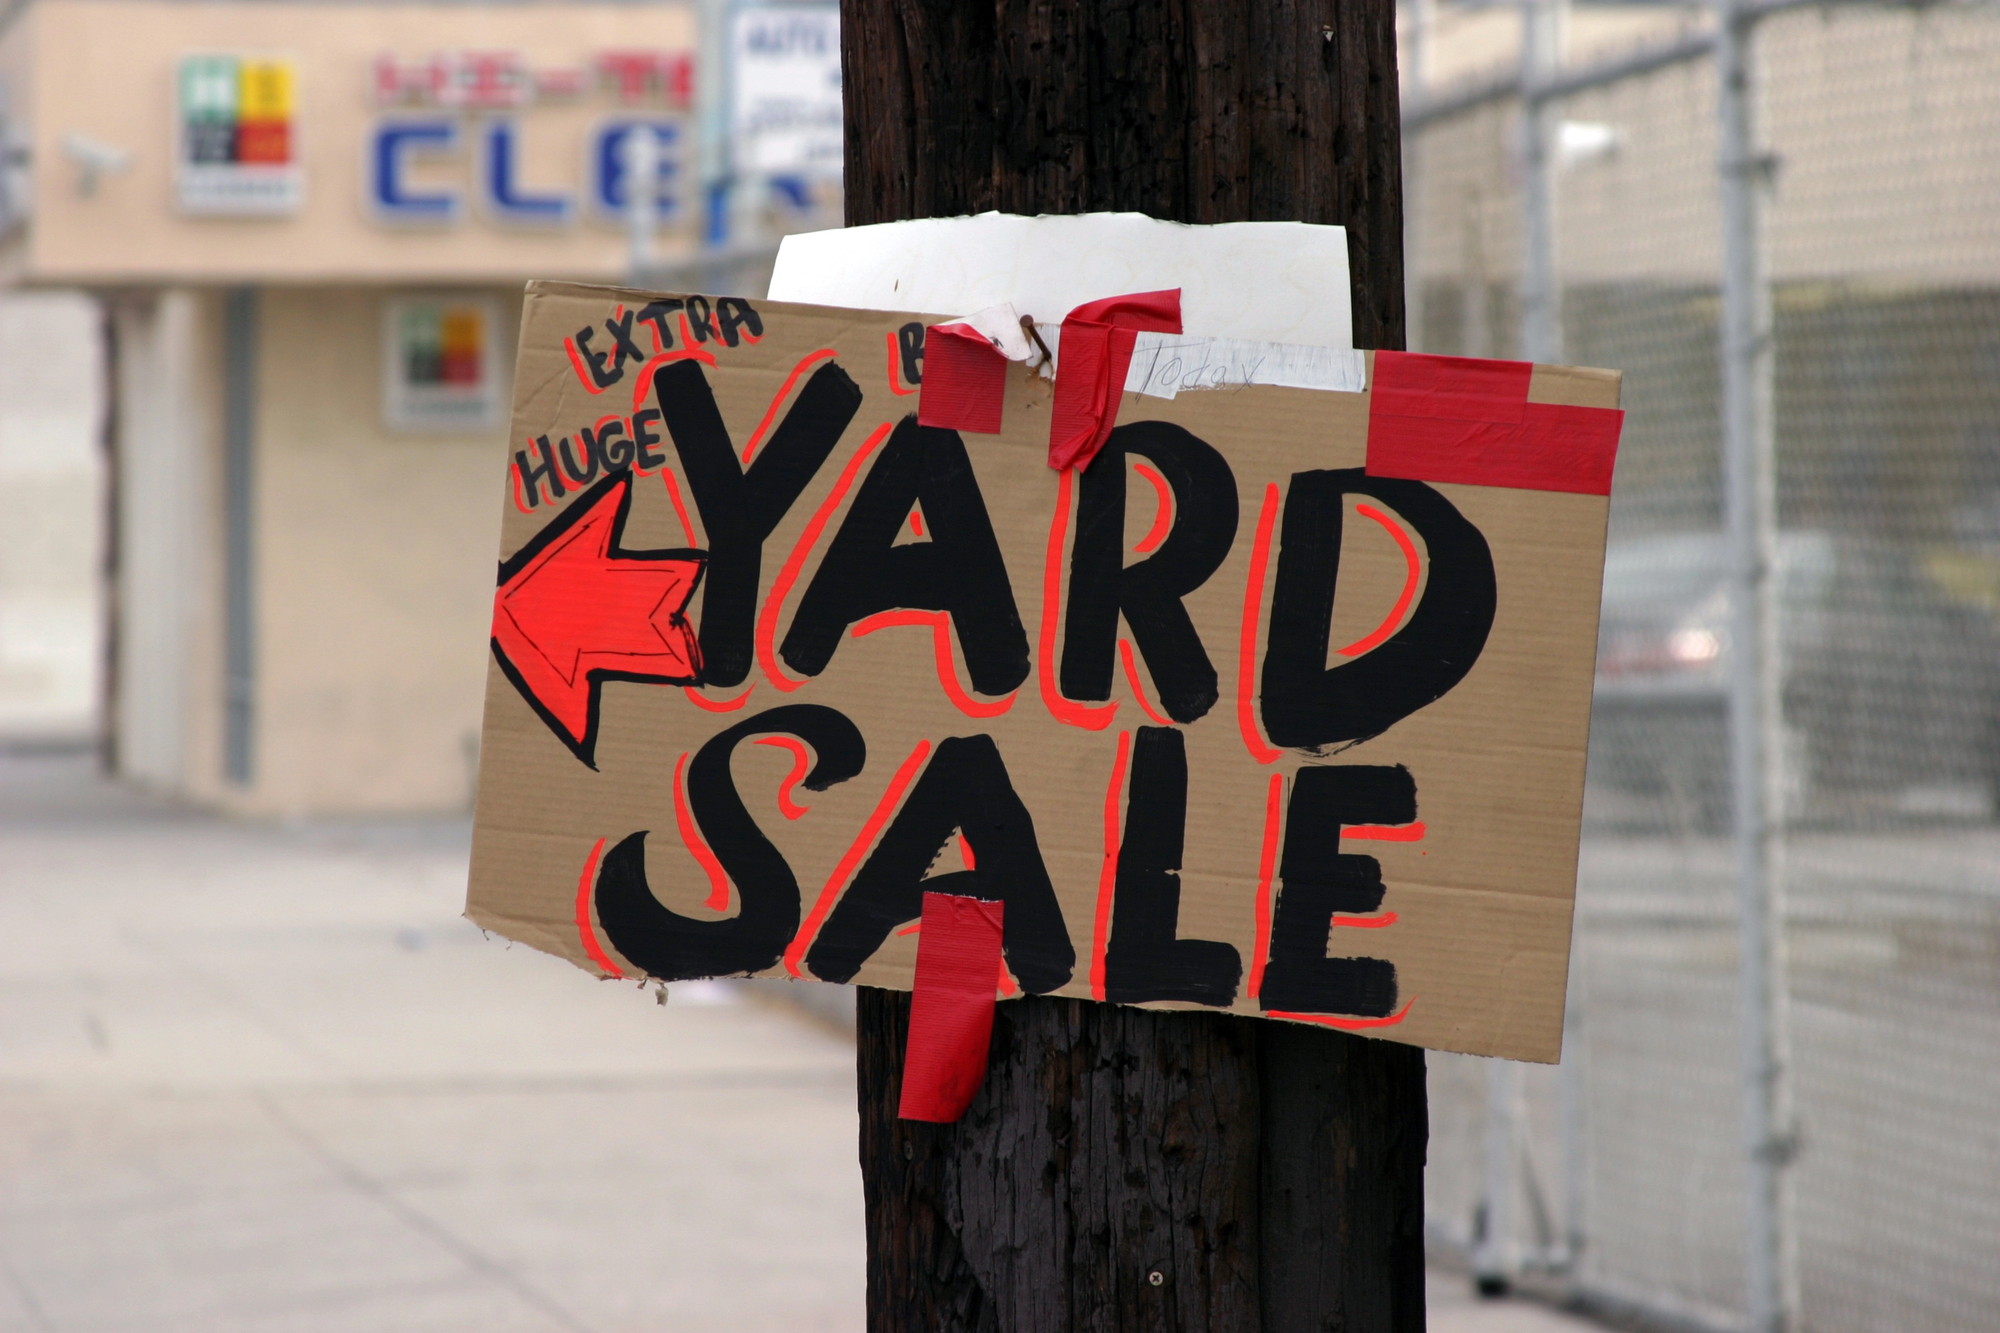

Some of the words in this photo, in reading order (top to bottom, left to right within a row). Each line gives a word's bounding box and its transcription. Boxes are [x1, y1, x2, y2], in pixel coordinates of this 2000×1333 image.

[372, 122, 678, 216] CLE
[570, 295, 764, 390] EXTRA
[513, 408, 667, 510] HUGE
[652, 357, 1497, 757] YARD
[590, 702, 1420, 1021] SALE
